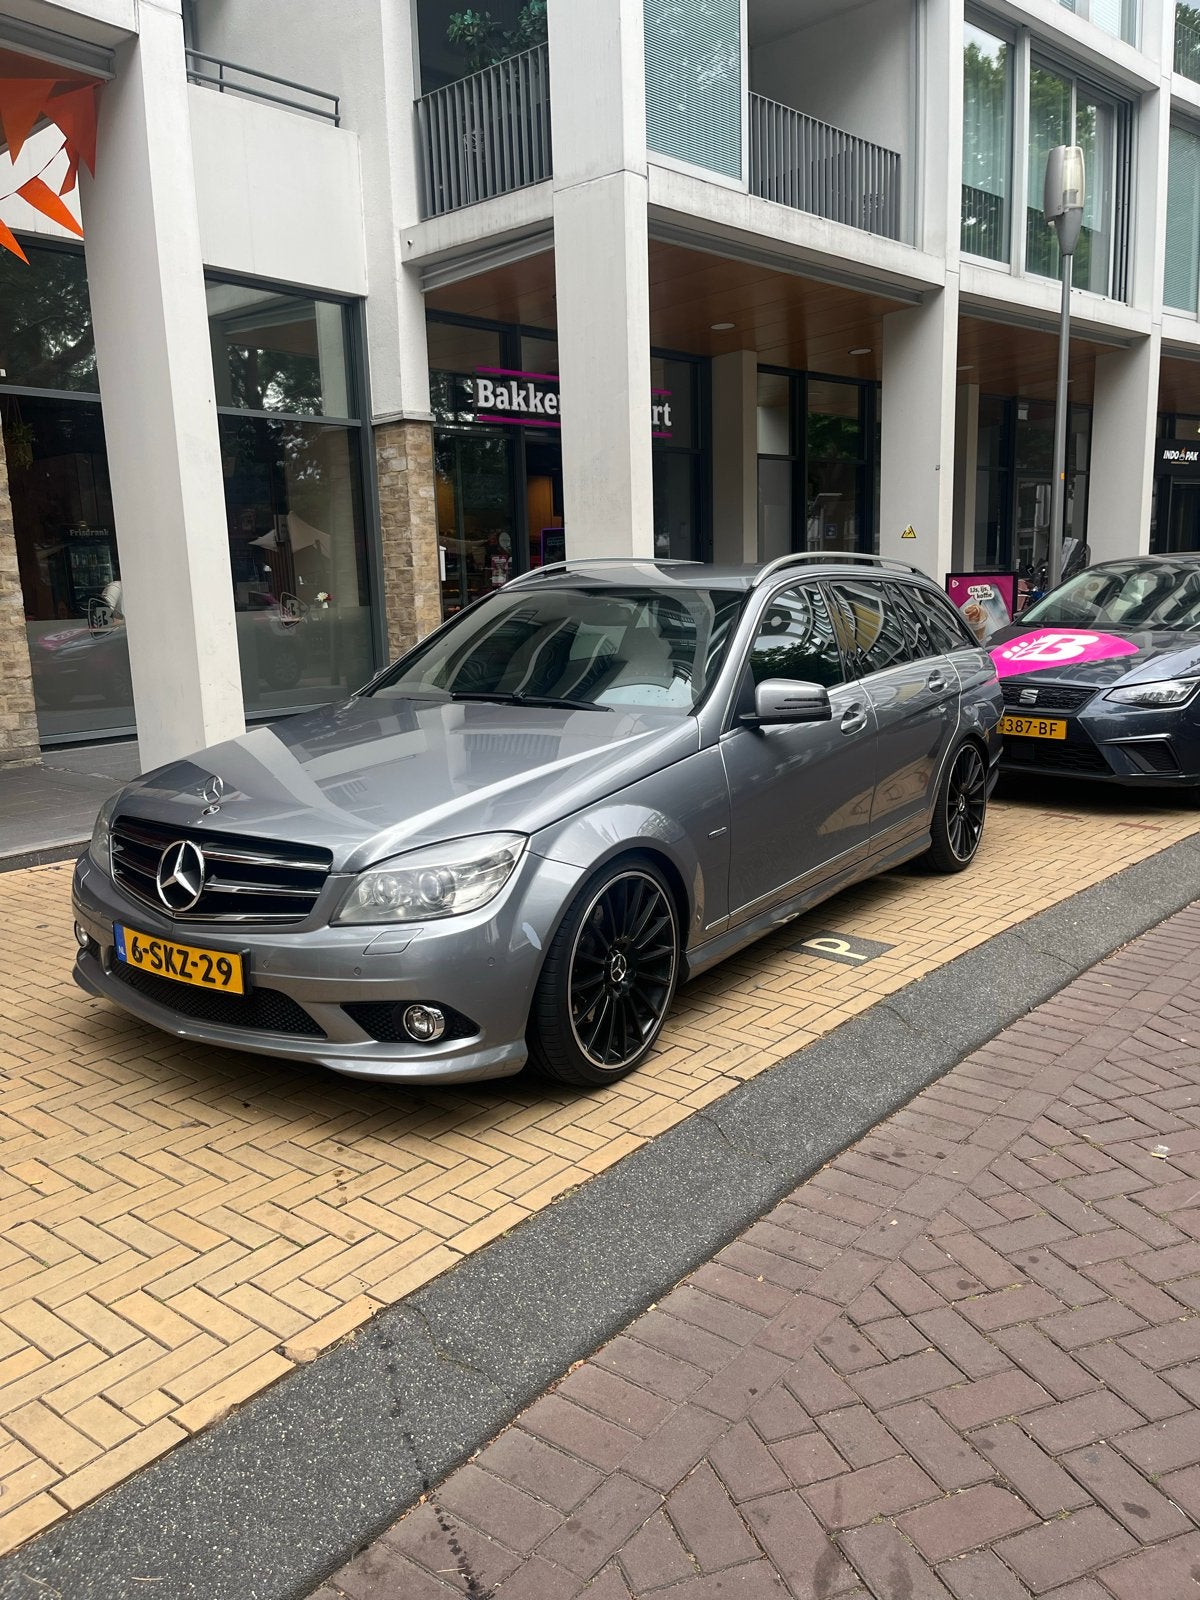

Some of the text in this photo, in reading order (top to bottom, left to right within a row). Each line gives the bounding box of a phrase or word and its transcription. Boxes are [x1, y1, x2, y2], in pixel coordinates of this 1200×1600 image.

[476, 378, 673, 427] Bakke rt
[1163, 450, 1199, 461] INDO PAK
[69, 529, 110, 537] Frisdrank
[1002, 718, 1058, 736] 387-BF
[131, 936, 233, 986] 6-SKZ-29
